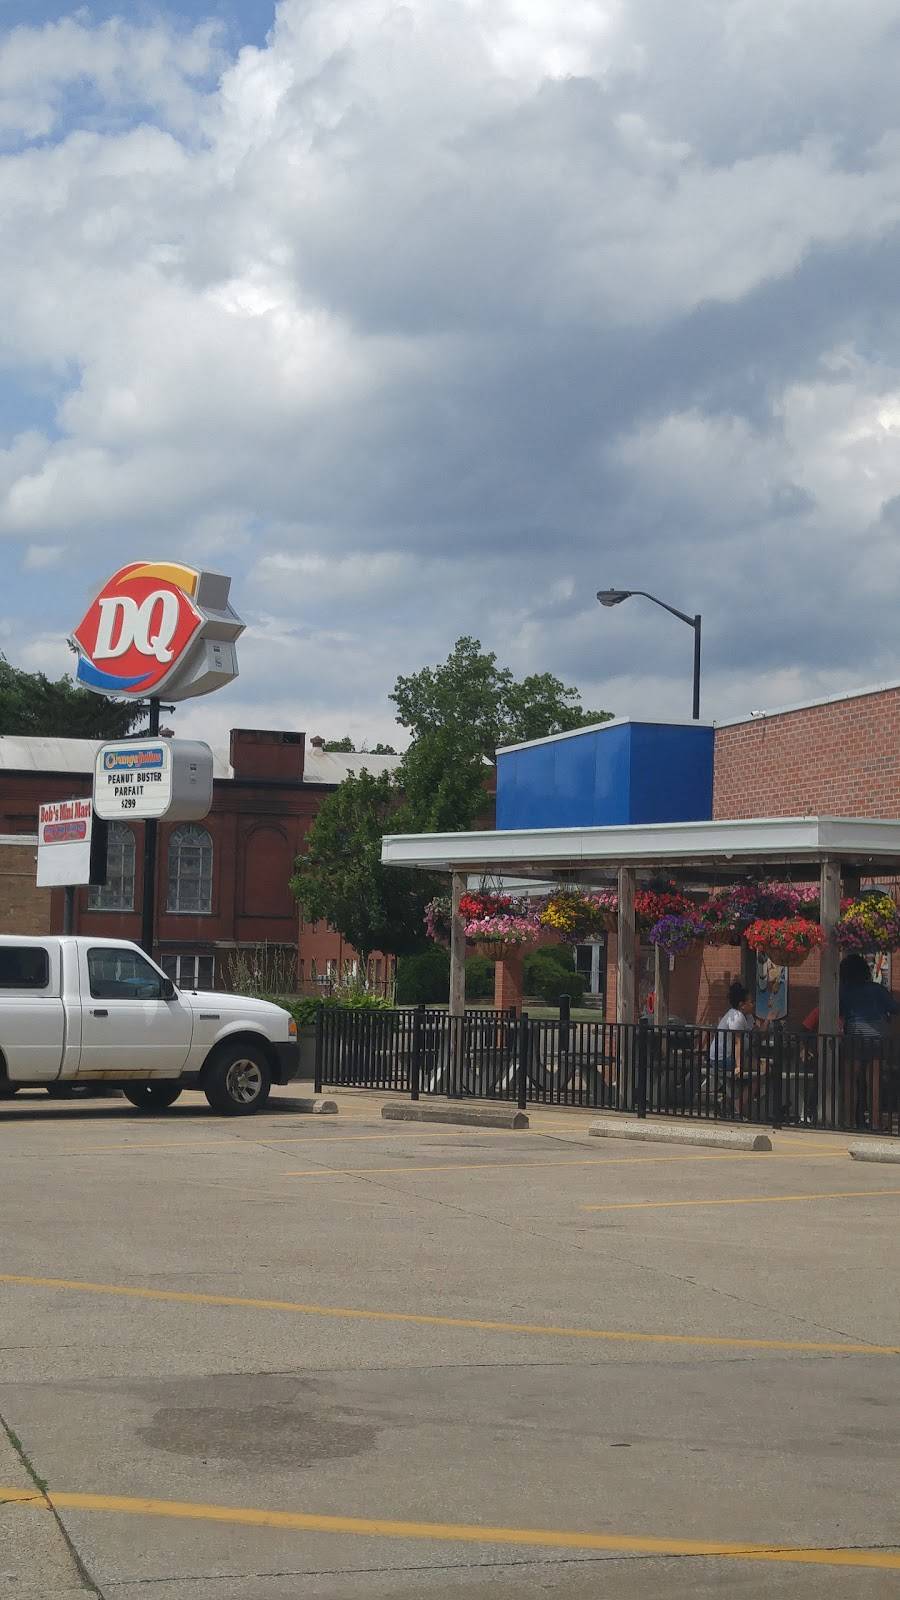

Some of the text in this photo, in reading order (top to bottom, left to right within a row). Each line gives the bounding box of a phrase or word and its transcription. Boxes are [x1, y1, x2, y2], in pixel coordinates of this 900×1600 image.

[92, 590, 179, 663] DQ
[108, 772, 162, 784] PEANUT BUSTER
[114, 786, 144, 797] PARFAIT
[121, 799, 136, 809] $299
[41, 805, 59, 823] Bob's
